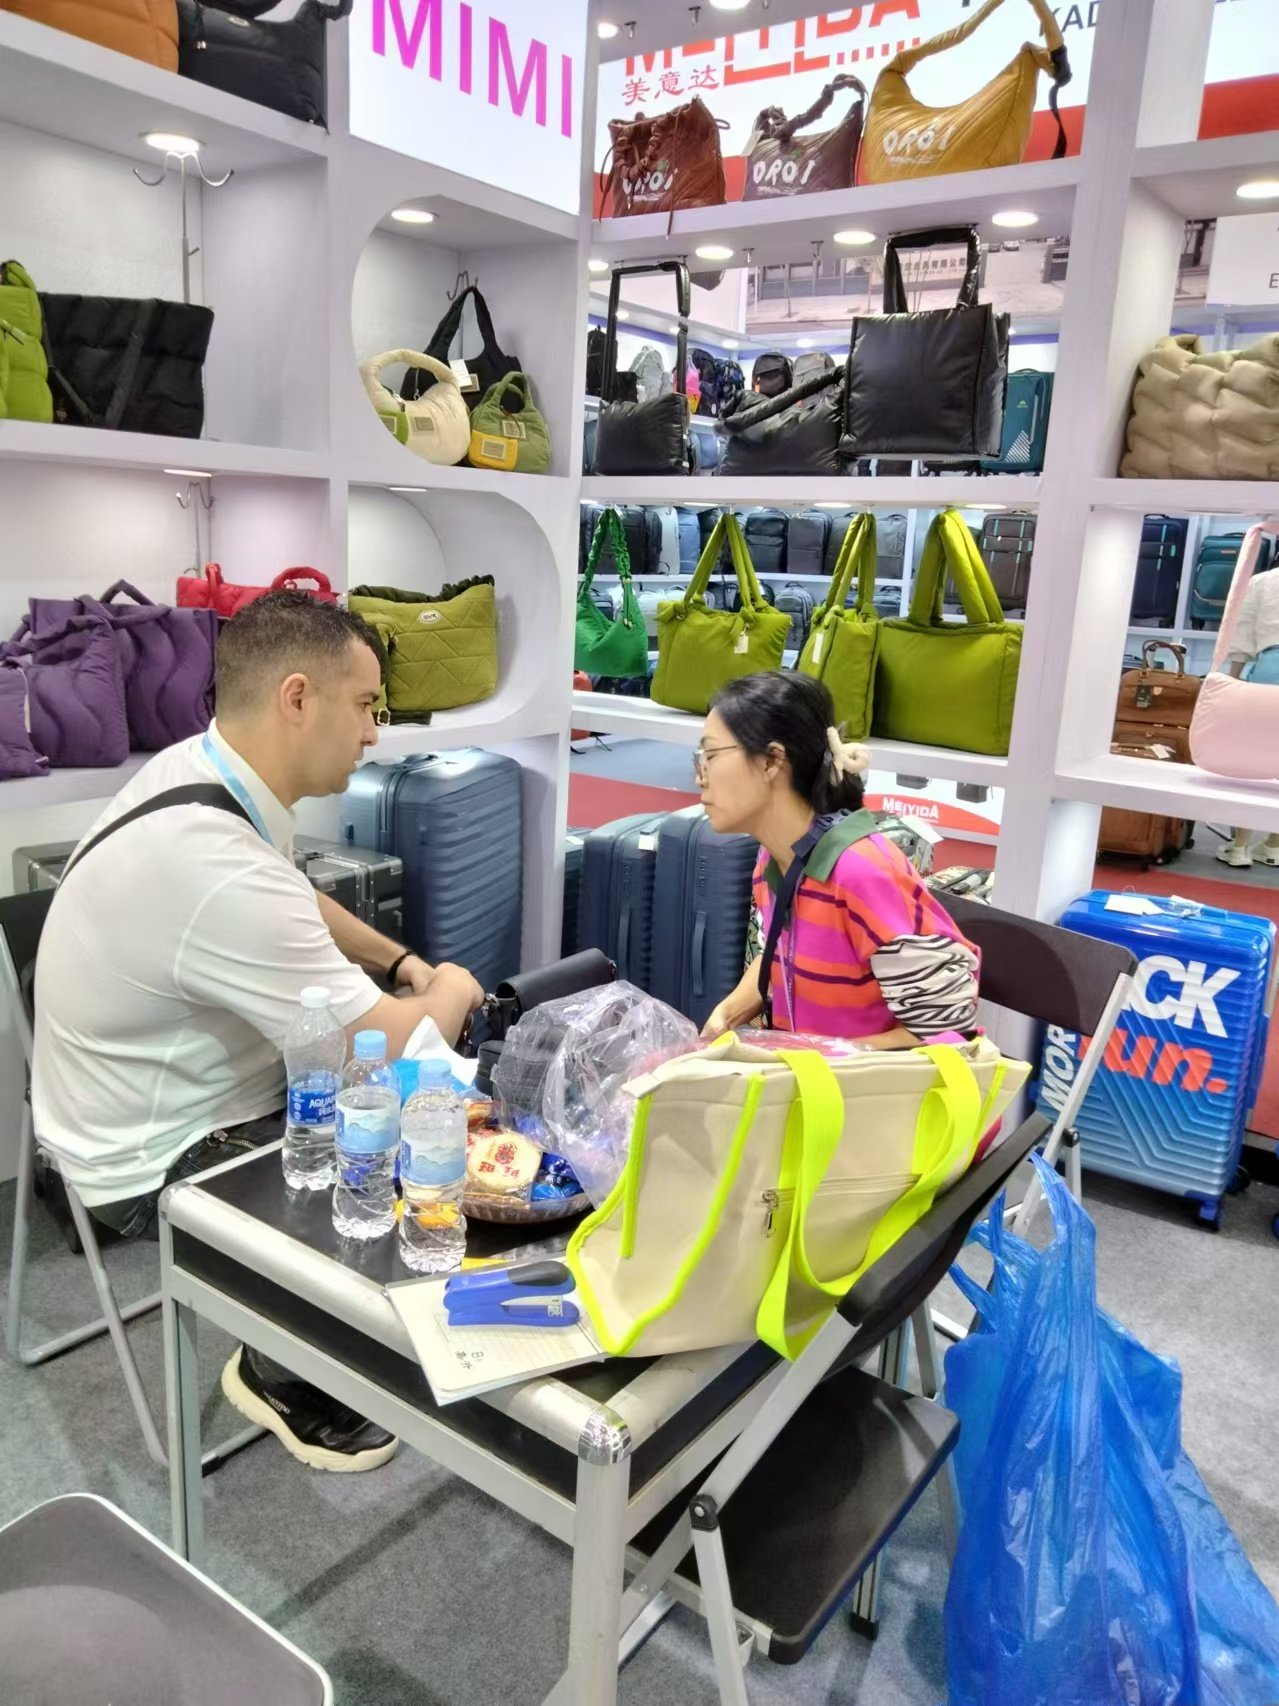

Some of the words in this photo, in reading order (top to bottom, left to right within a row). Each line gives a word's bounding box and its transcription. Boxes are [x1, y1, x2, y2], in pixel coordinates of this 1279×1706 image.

[372, 0, 573, 139] MIMI
[622, 64, 720, 106] 美意达
[882, 796, 940, 819] MEIYIDA
[1120, 954, 1240, 1039] CK
